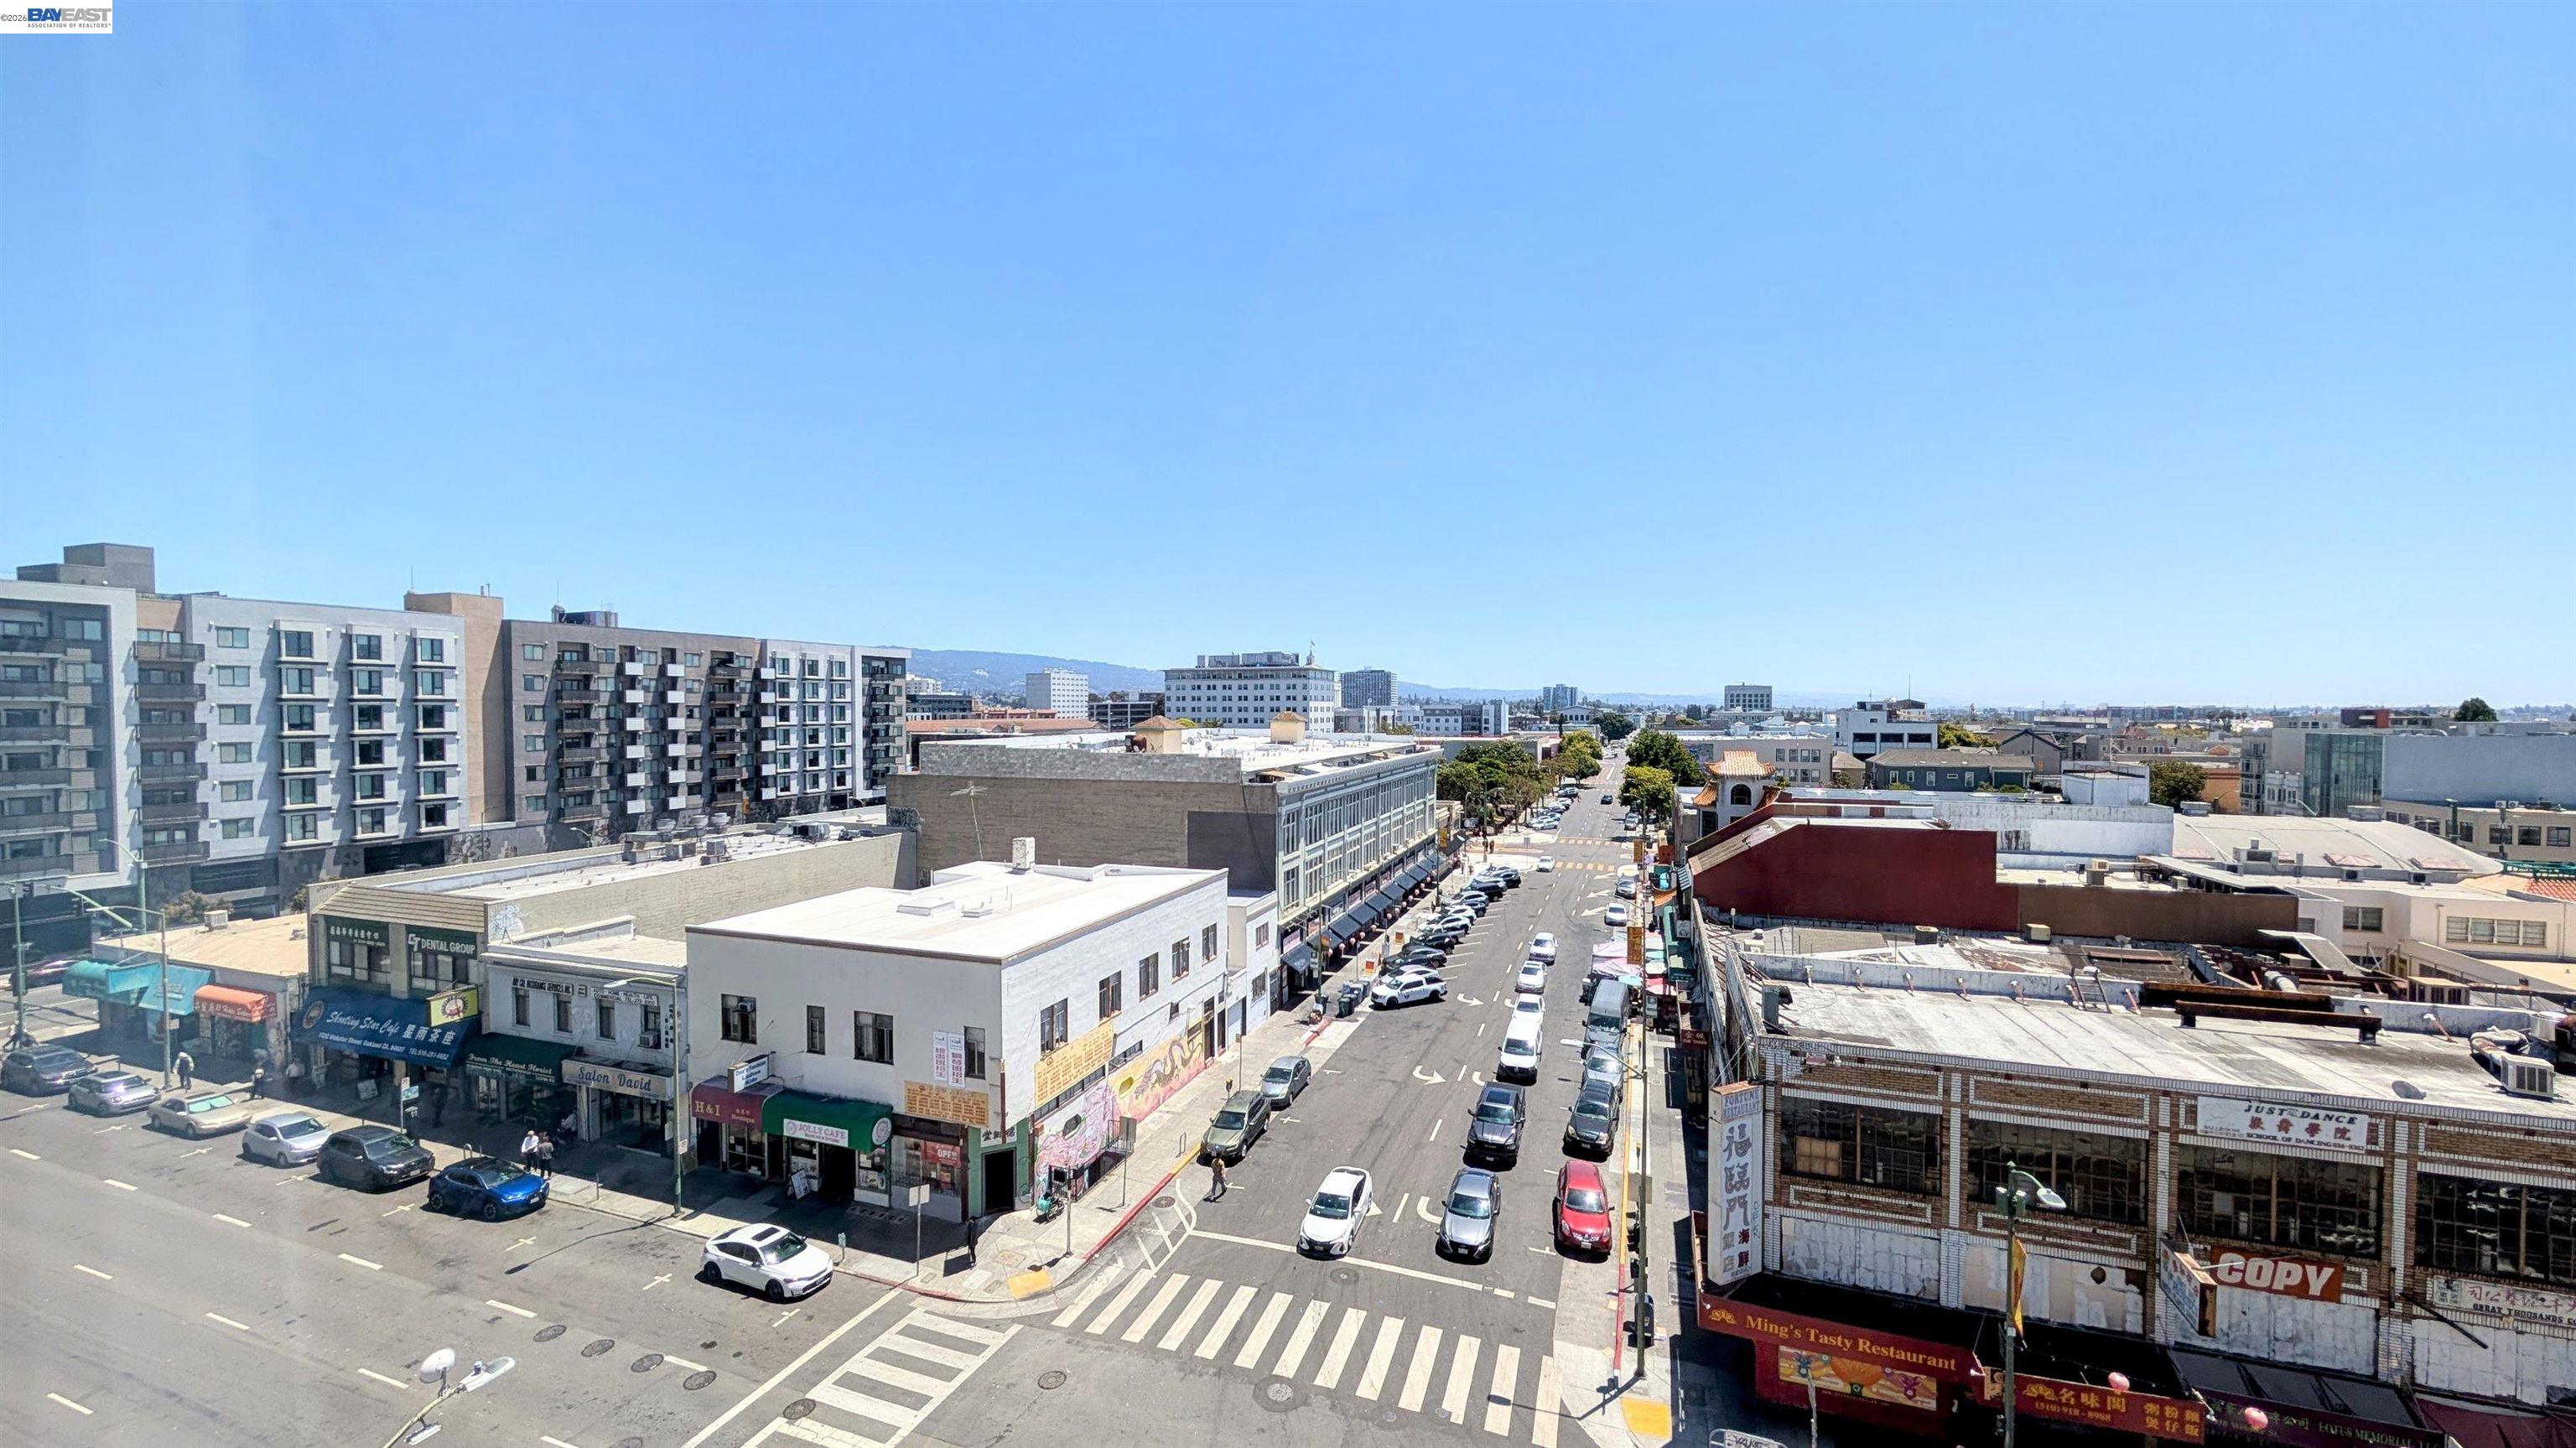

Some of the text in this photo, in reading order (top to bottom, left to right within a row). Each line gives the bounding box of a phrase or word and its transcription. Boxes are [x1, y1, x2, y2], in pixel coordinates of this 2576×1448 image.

[421, 938, 449, 952] DENTAL
[449, 942, 475, 954] GROUP
[578, 1067, 652, 1091] Salon David
[1722, 1101, 1761, 1118] RESTAURANT
[1724, 1091, 1759, 1108] FORTUNE
[2244, 1103, 2287, 1117] JUST
[2299, 1109, 2360, 1126] DANCE
[798, 1124, 823, 1135] JOLLY
[823, 1128, 846, 1139] CAFE
[2246, 1132, 2279, 1141] SCHOOL
[2294, 1137, 2332, 1148] DANCING
[1722, 1123, 1753, 1231] 福臨門
[2216, 1253, 2335, 1296] COPY
[2473, 1303, 2503, 1315] GREAT
[2507, 1308, 2563, 1324] THOUSANDS
[1745, 1315, 1958, 1371] Ming's Tasty Restaurant
